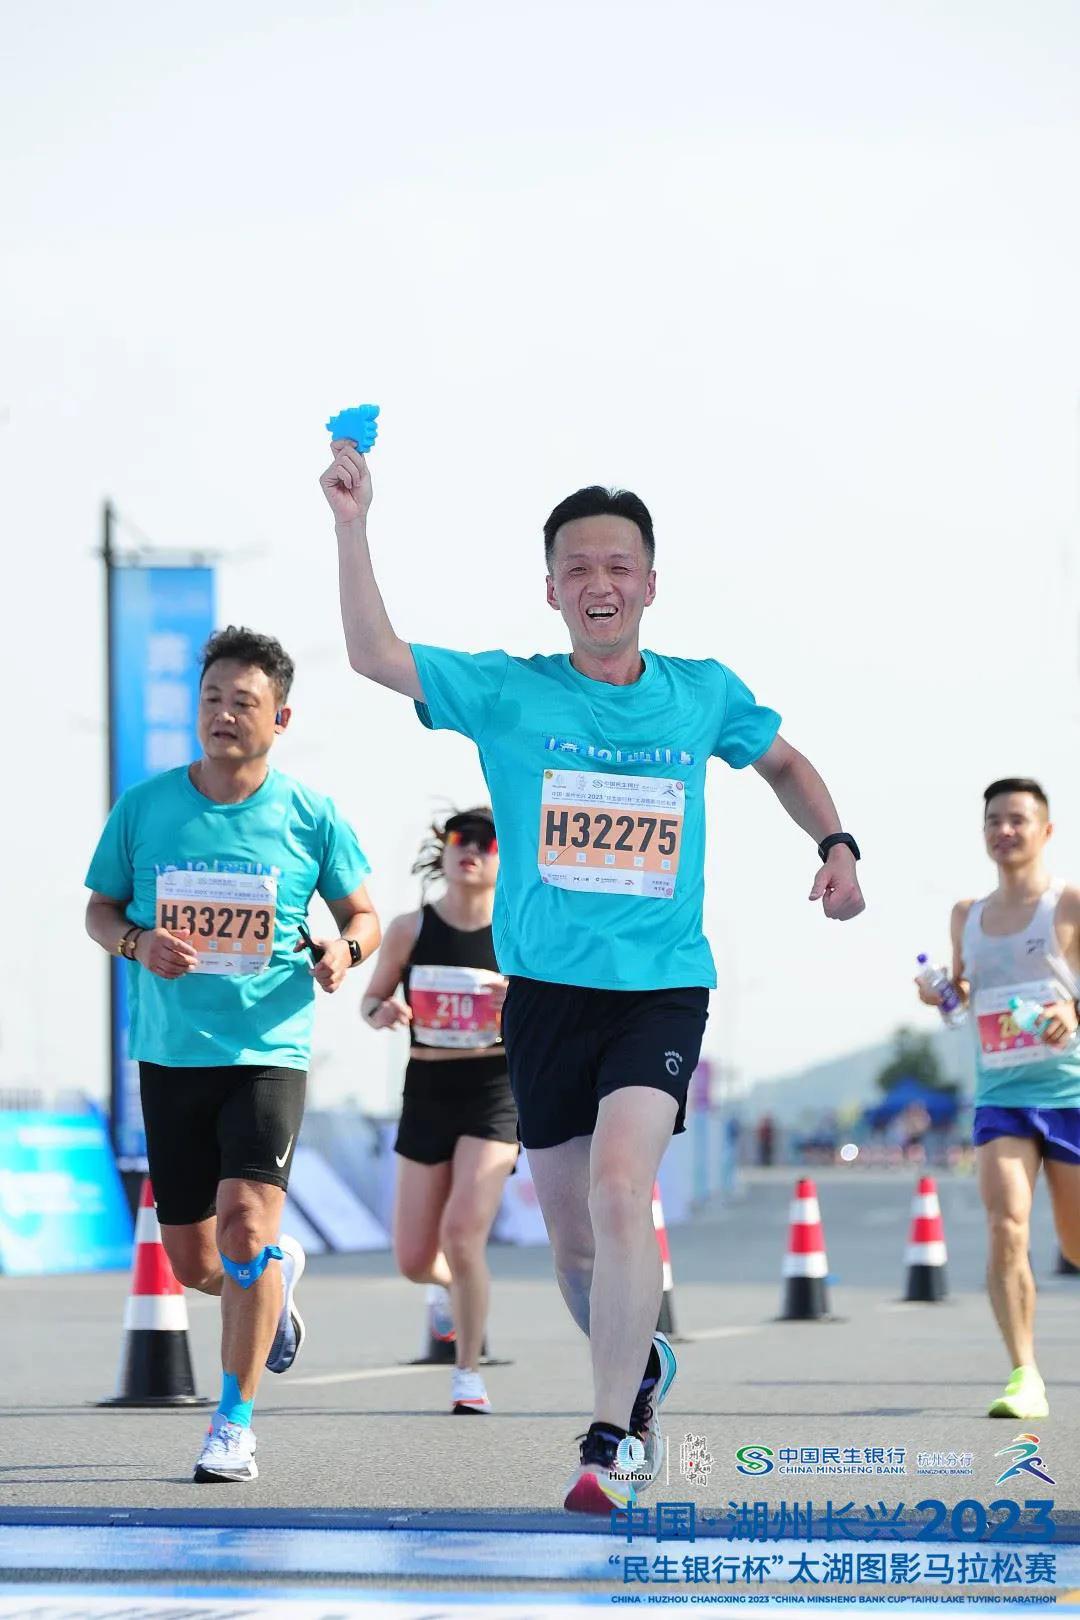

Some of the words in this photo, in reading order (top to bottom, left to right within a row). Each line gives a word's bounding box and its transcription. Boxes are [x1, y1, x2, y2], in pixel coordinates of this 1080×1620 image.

[545, 810, 678, 855] H32275
[161, 904, 270, 940] H33273
[436, 993, 474, 1019] 210
